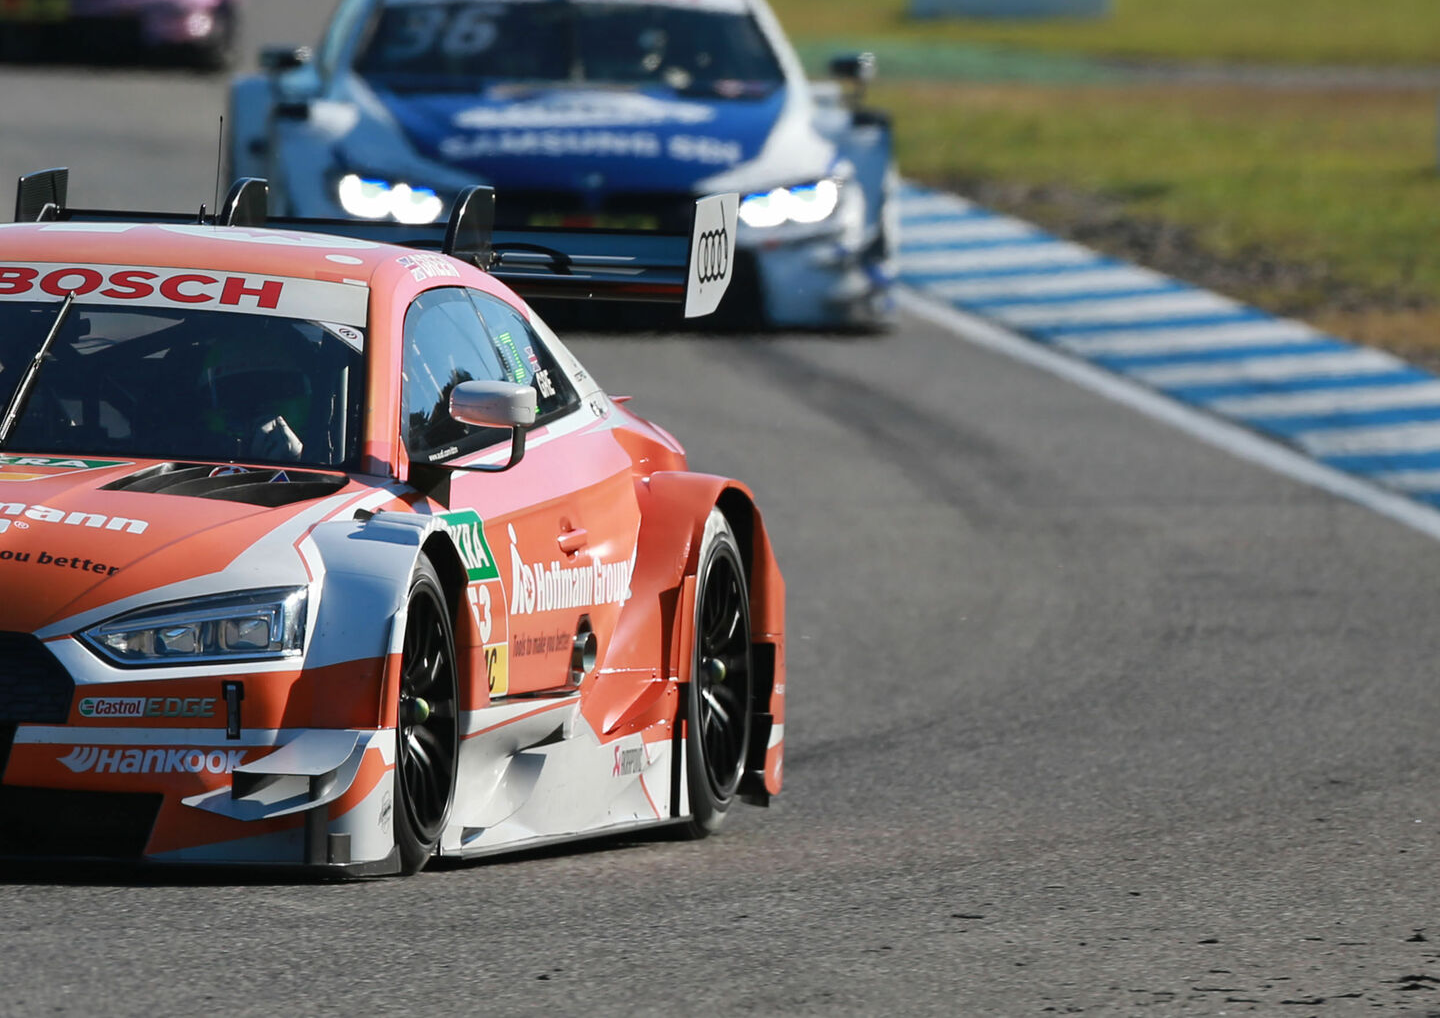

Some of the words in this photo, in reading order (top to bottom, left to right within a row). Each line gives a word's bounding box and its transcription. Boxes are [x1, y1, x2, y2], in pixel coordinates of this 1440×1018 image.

[385, 3, 508, 61] 36
[36, 550, 120, 578] better
[533, 560, 594, 613] Hoffmann
[95, 699, 141, 715] Castrol
[144, 697, 217, 718] EDGE
